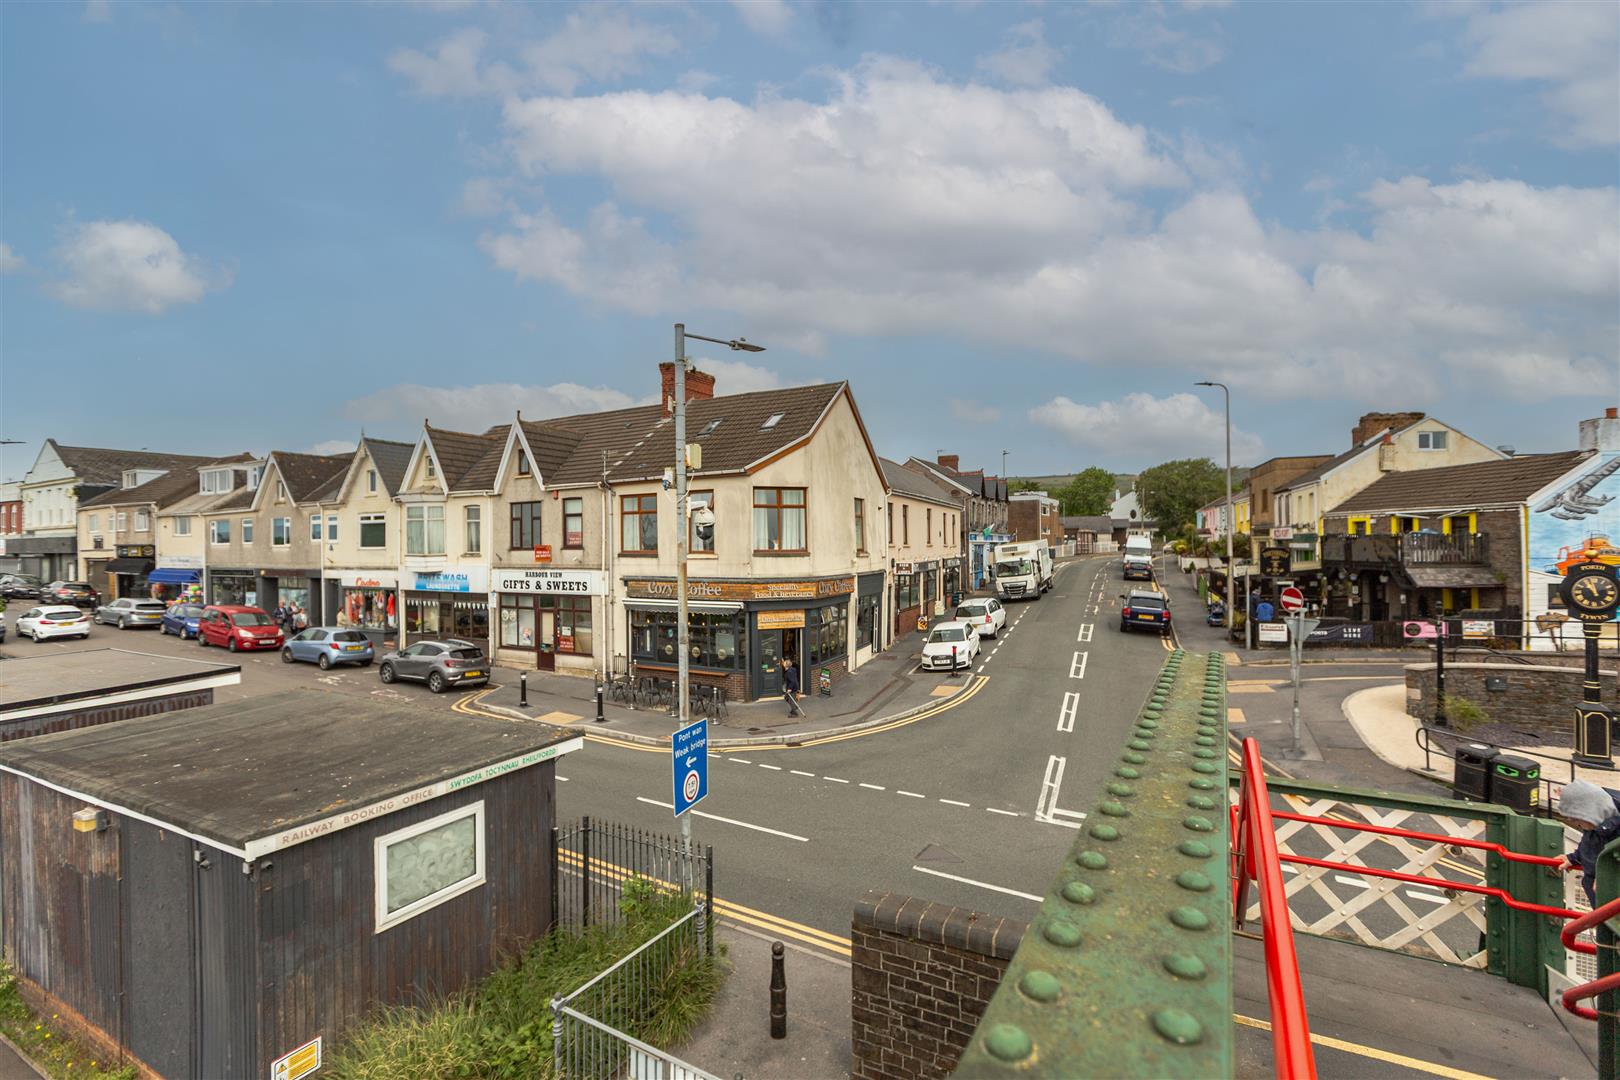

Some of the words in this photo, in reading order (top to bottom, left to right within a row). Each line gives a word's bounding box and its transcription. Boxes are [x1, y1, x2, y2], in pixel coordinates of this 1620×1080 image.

[503, 580, 530, 589] GIFTS
[535, 581, 542, 590] &
[546, 580, 588, 591] SWEETS
[647, 582, 673, 596] Cozy
[678, 731, 691, 743] Pont
[692, 727, 703, 736] wan
[674, 745, 689, 759] Weak
[690, 738, 706, 750] bridge
[282, 820, 335, 845] RAILWAY
[343, 801, 395, 824] BOOKING
[402, 788, 433, 804] OFFICE
